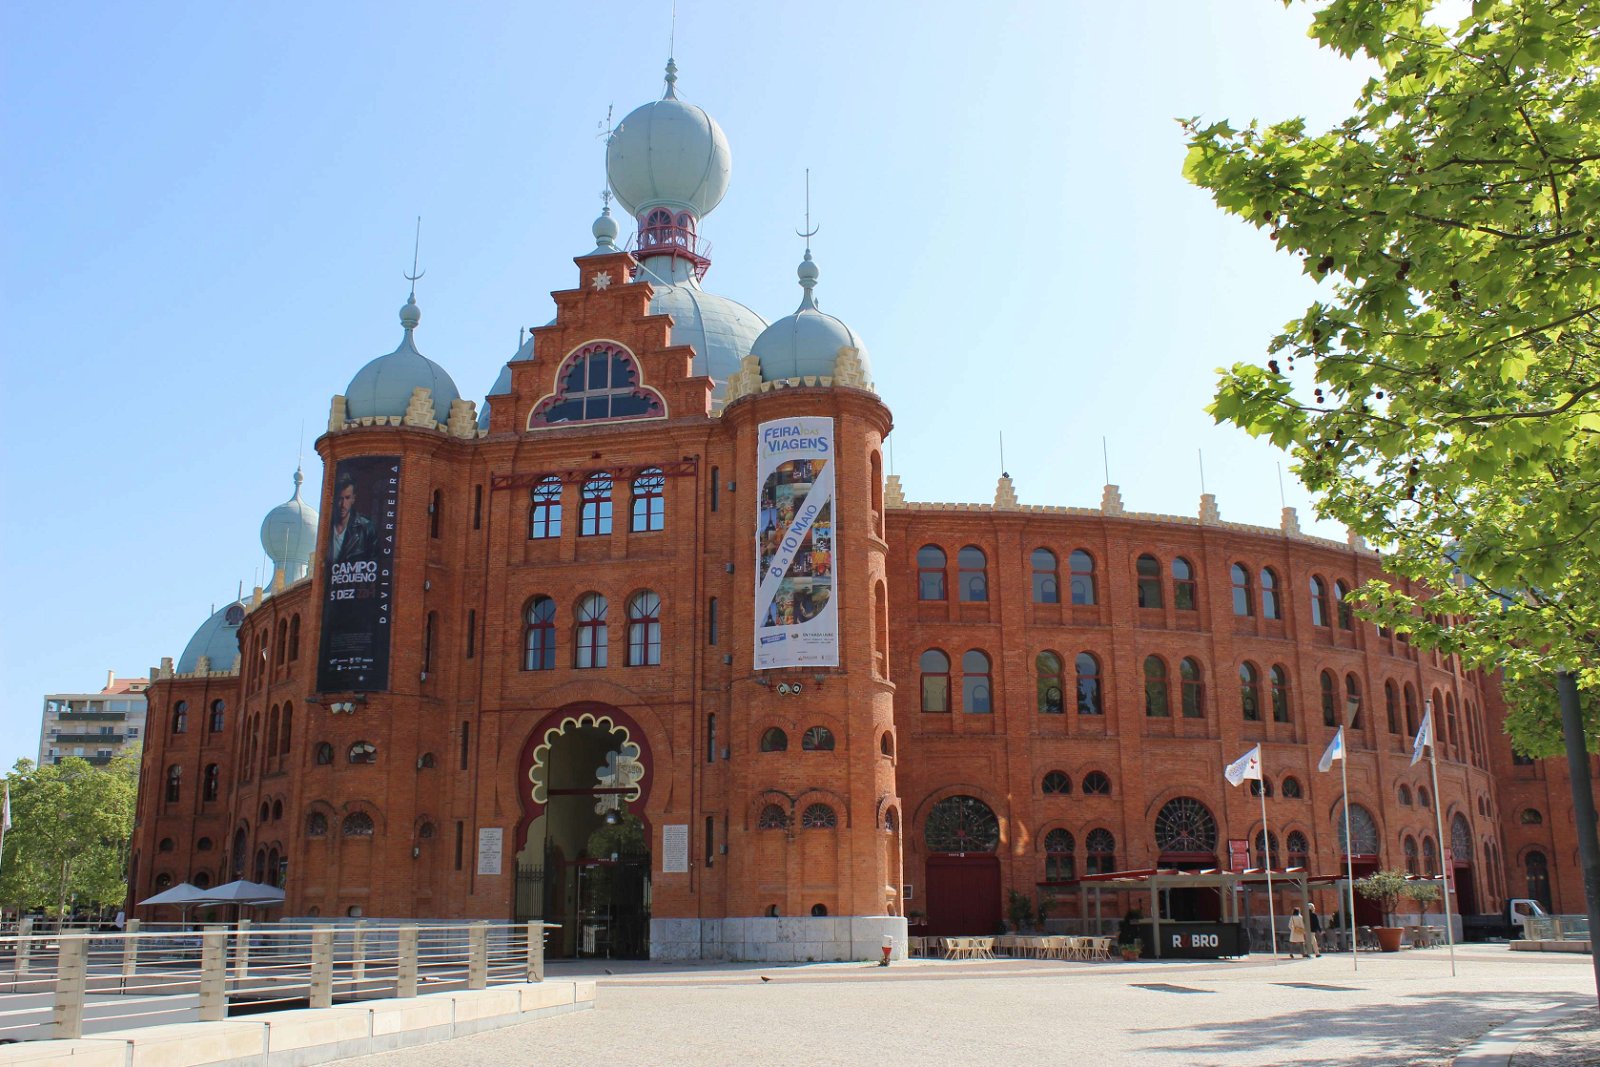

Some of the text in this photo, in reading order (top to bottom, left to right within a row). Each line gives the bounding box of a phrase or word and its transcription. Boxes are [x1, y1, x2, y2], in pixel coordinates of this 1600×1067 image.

[764, 425, 801, 443] FEIRA
[767, 436, 829, 452] VIAGENS
[378, 464, 398, 624] DAVID CARREIRA
[770, 566, 783, 577] 8
[782, 536, 797, 554] 10
[790, 504, 817, 536] MAIO
[331, 560, 377, 575] CAMPO
[331, 572, 376, 585] PEQUENO
[330, 590, 336, 601] 5
[336, 588, 355, 600] DEZ
